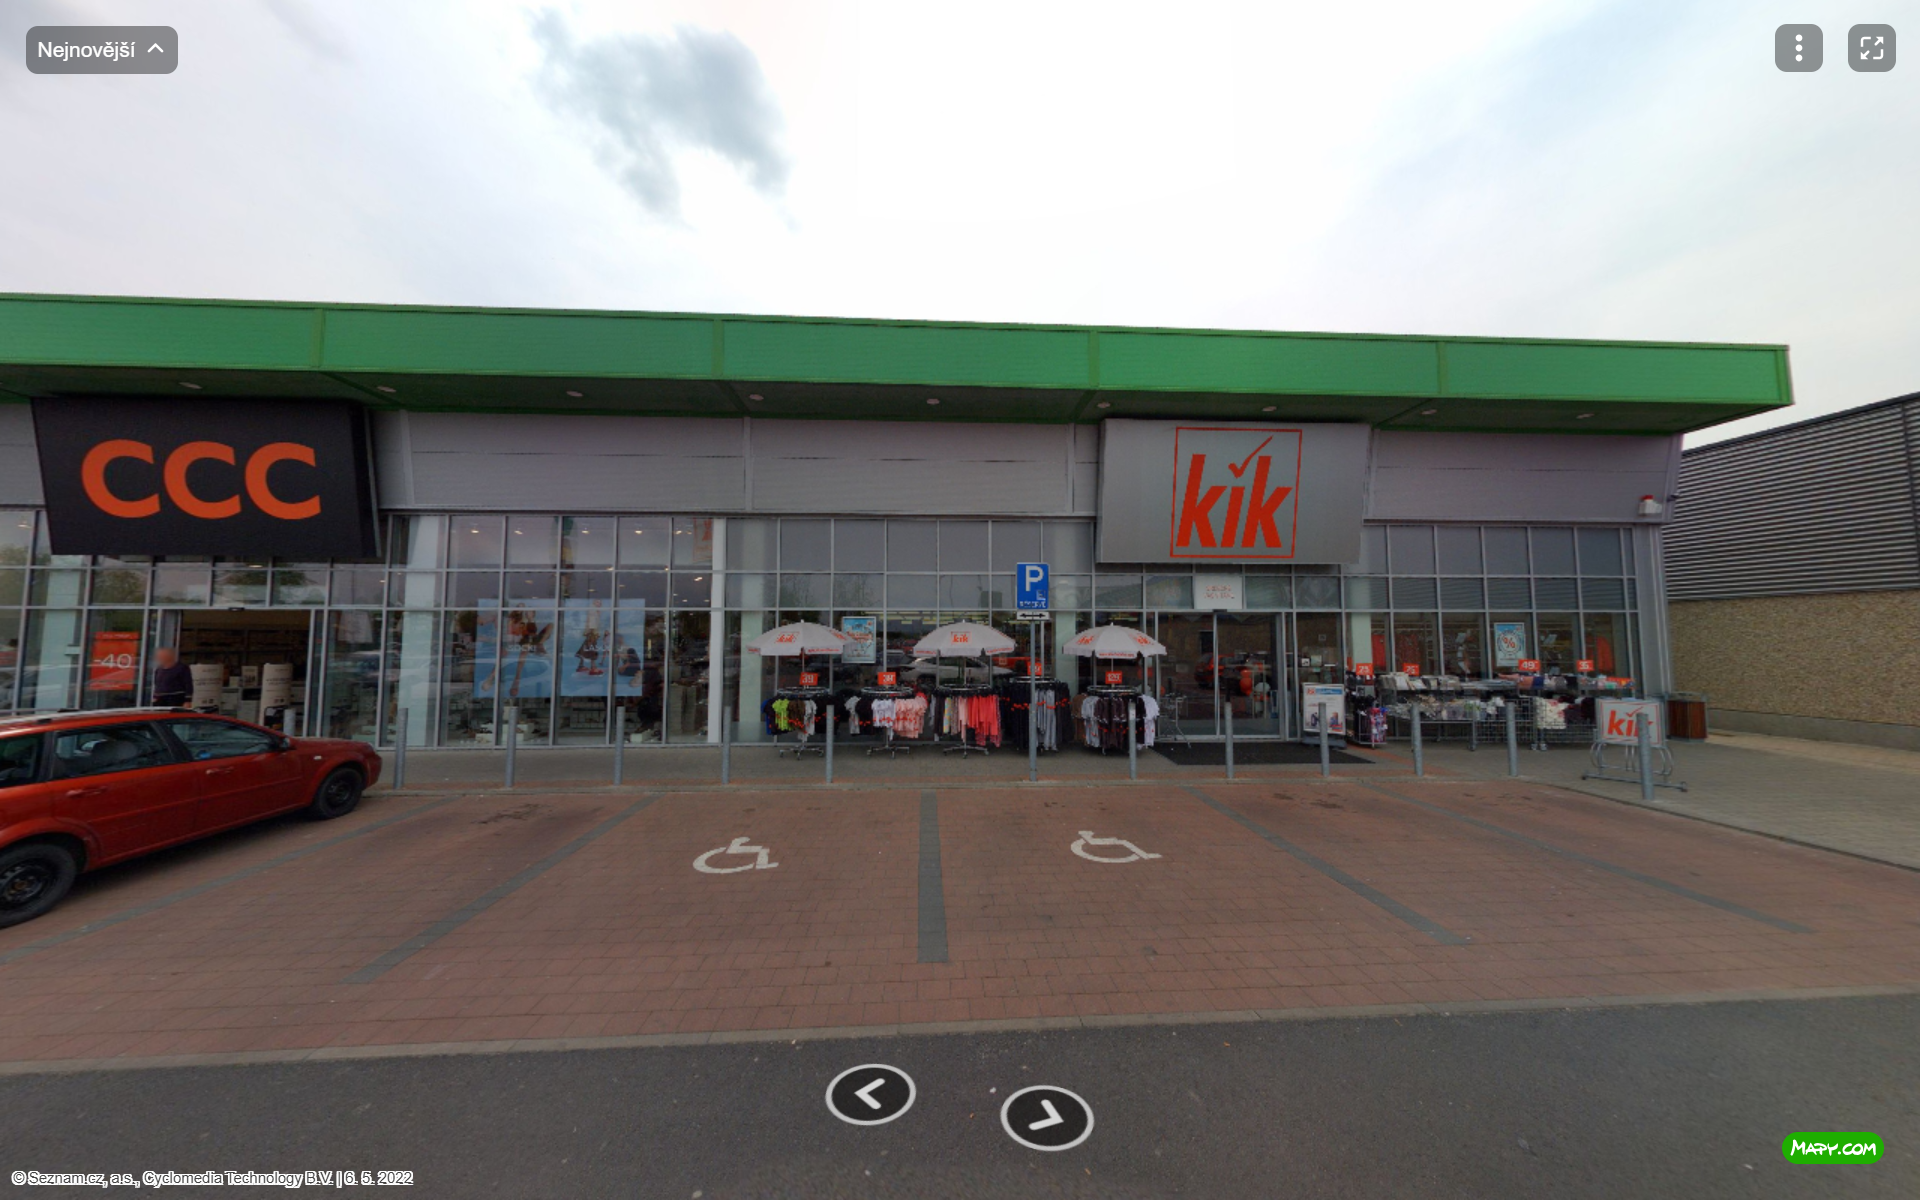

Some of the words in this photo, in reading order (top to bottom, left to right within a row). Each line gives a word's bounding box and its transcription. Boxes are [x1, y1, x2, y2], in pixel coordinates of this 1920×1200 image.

[80, 439, 322, 520] CCC
[1175, 434, 1293, 549] kik
[1025, 565, 1044, 592] P
[953, 633, 969, 643] kik
[1606, 706, 1653, 737] ki
